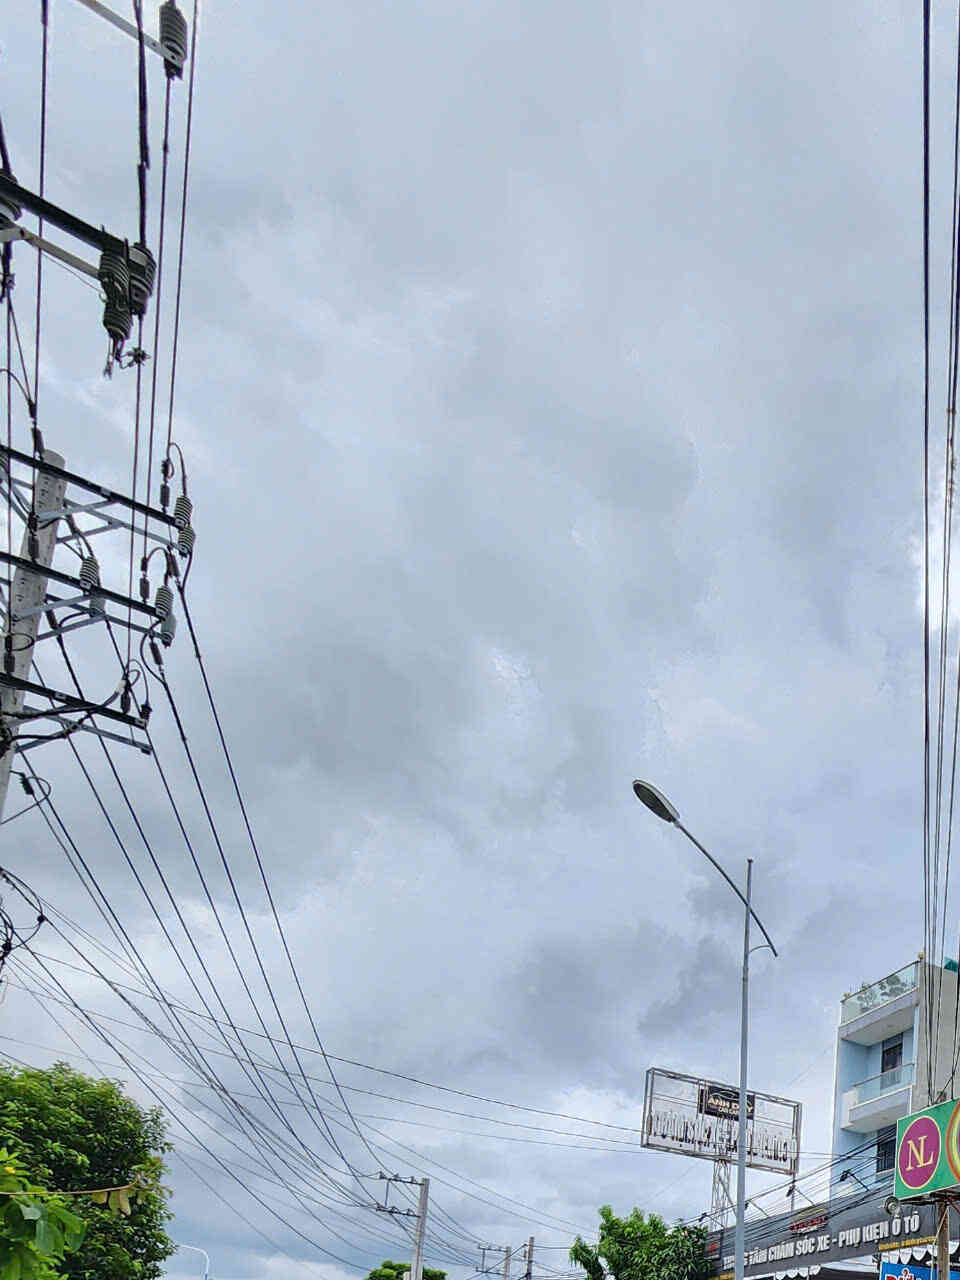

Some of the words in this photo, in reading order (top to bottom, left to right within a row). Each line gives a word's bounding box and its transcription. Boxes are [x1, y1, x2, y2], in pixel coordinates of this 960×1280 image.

[796, 1235, 816, 1256] SÓC
[816, 1234, 830, 1252] XE
[838, 1226, 860, 1248] PHỤ
[862, 1219, 889, 1244] KIỆN
[891, 1214, 902, 1236] Ô
[903, 1210, 920, 1234] TÔ
